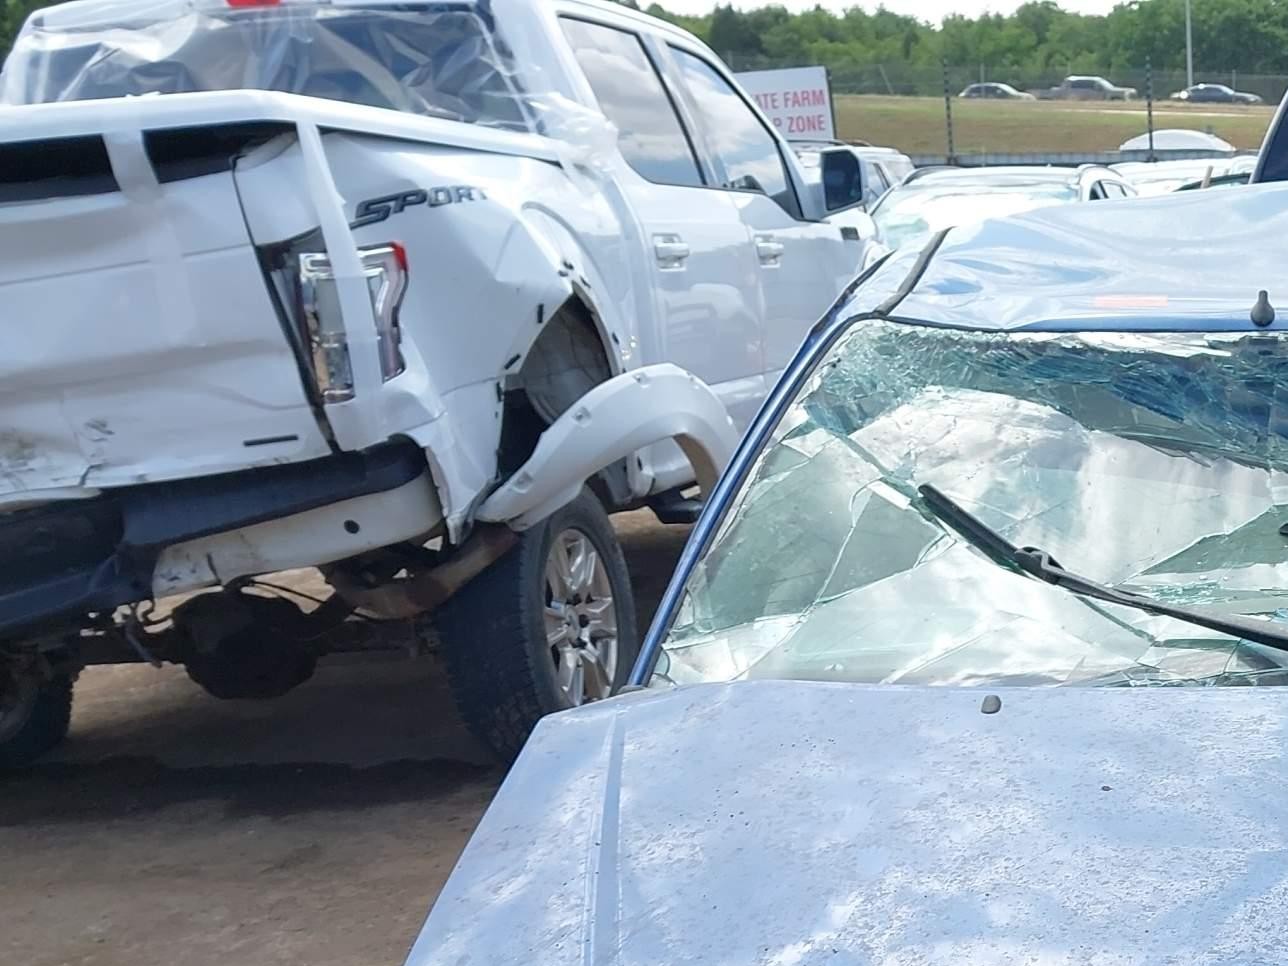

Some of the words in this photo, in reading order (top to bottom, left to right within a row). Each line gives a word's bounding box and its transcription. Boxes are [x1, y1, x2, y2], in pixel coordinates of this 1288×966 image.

[752, 92, 779, 110] ATE
[783, 89, 826, 108] FARM
[787, 114, 826, 133] ZONE
